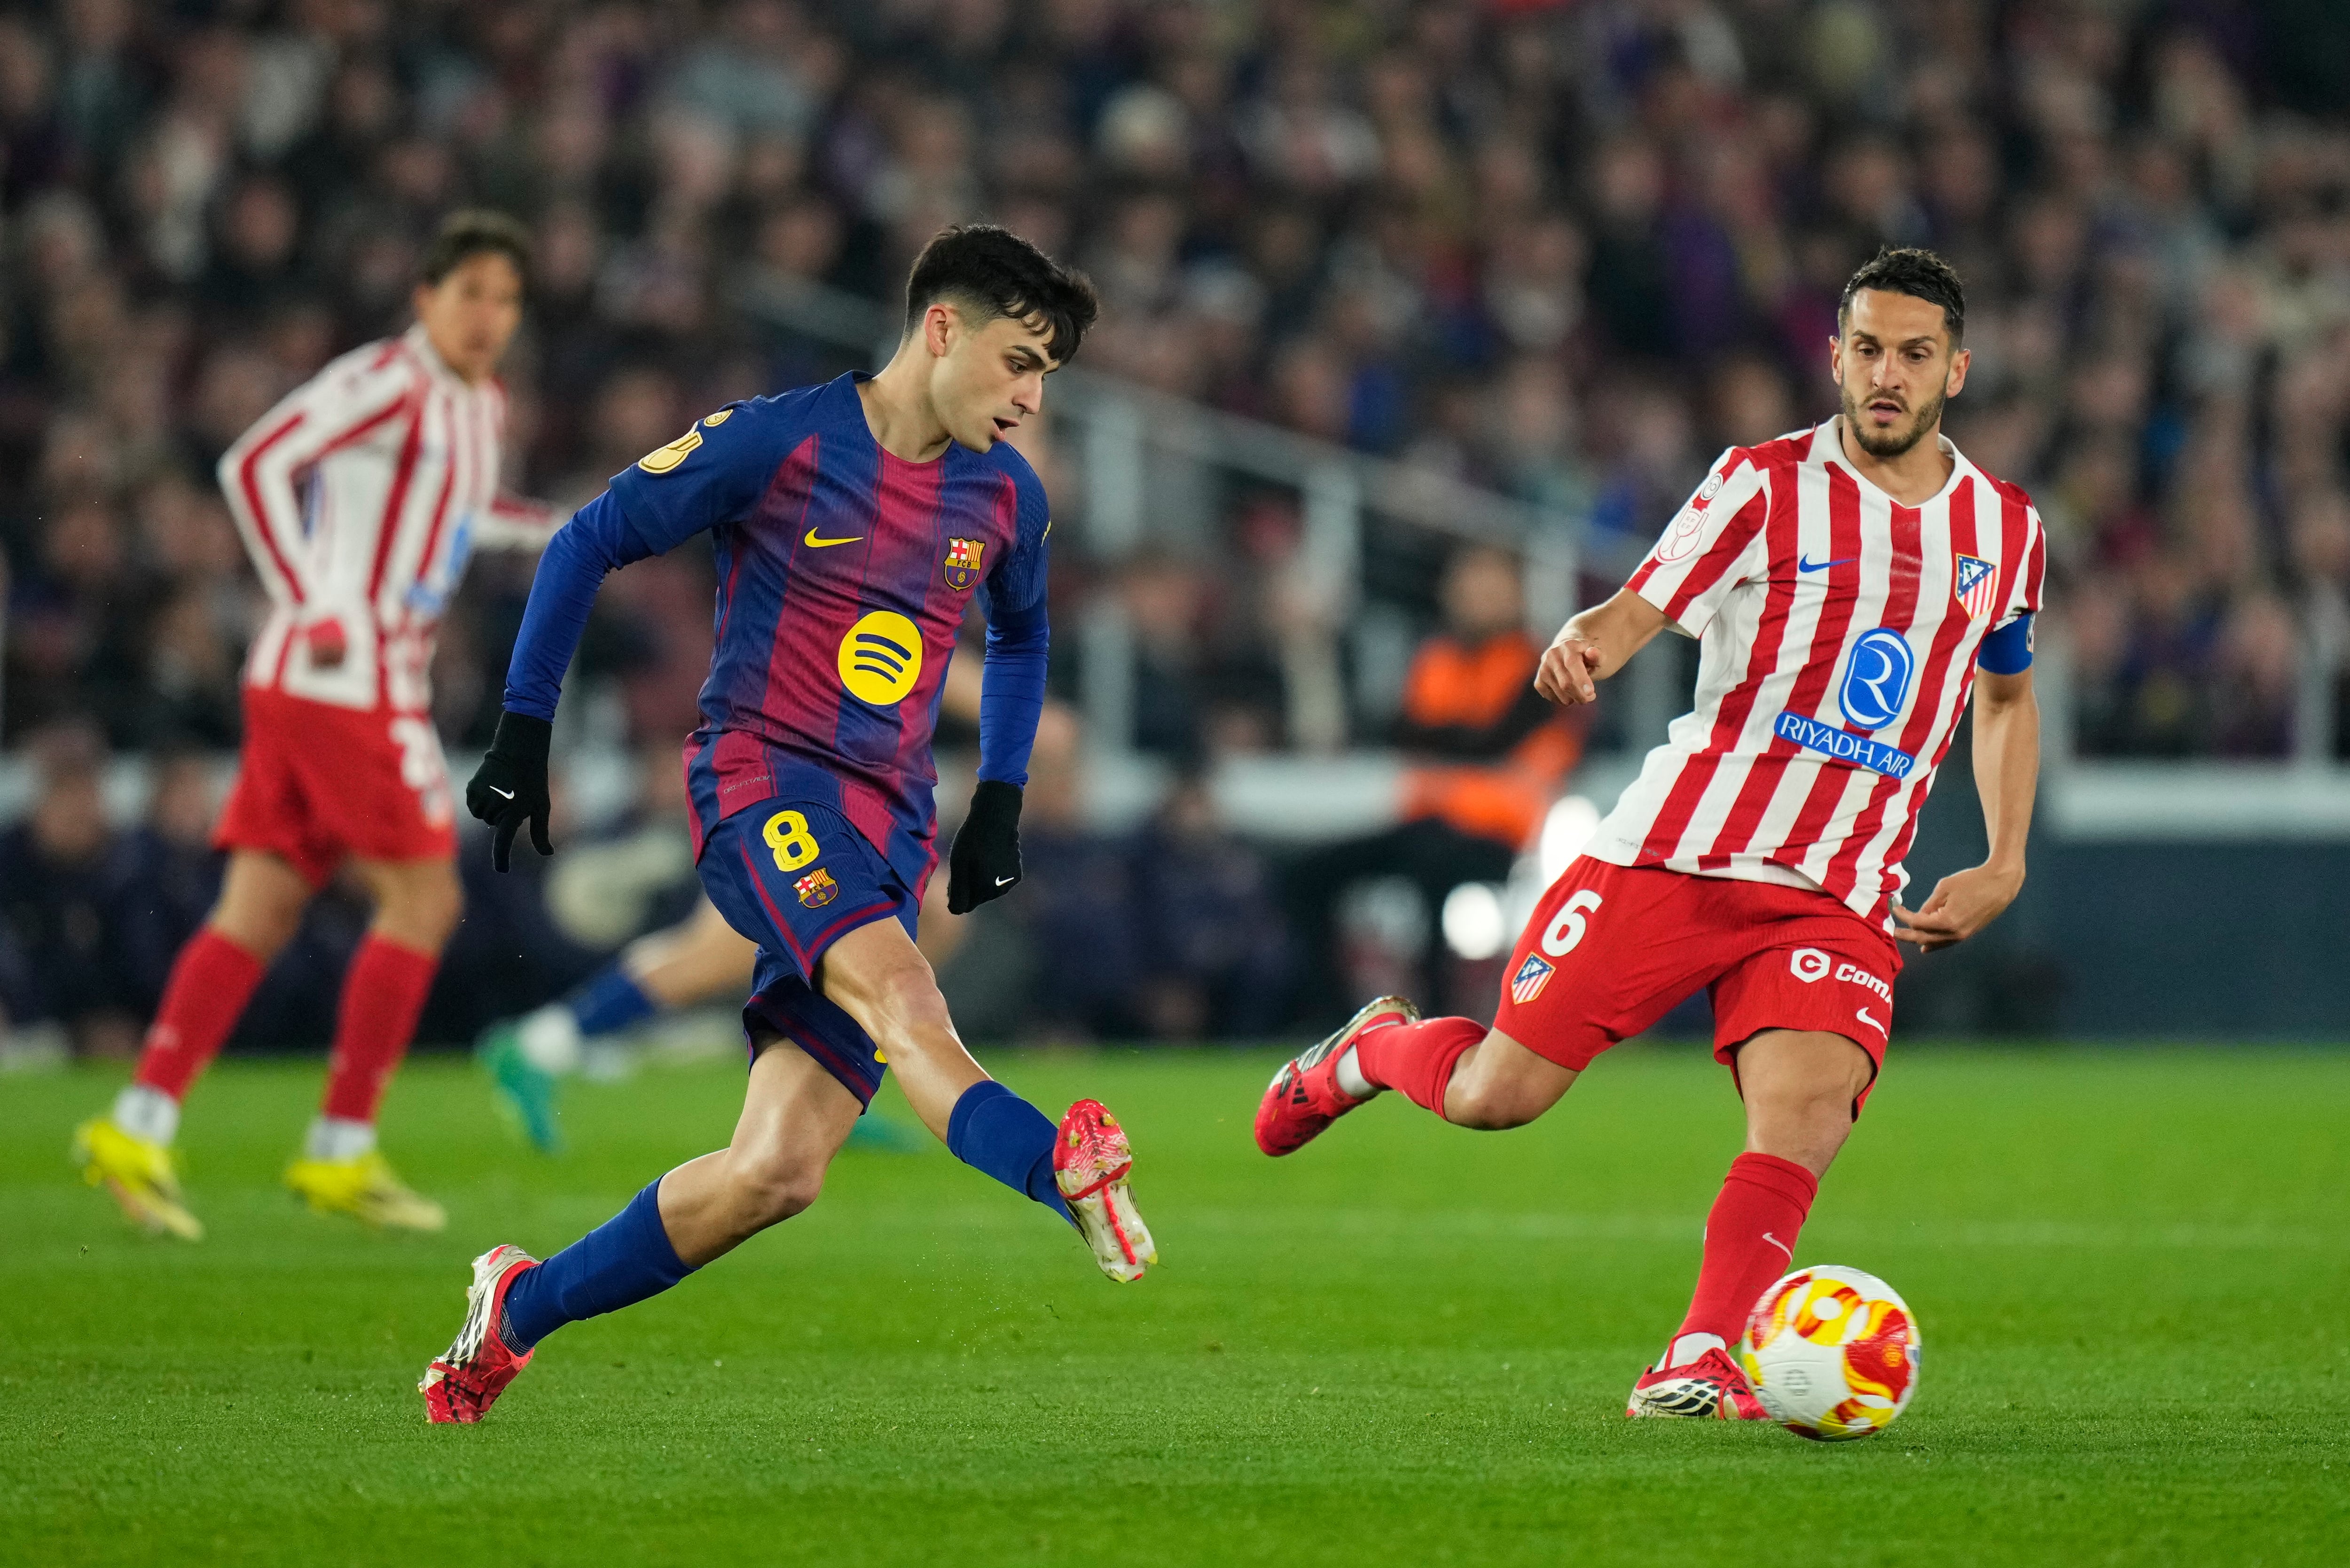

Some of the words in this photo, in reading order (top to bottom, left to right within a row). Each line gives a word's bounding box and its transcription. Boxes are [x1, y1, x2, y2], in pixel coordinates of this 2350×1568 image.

[1780, 714, 1875, 764] RIYADH
[1877, 750, 1910, 777] AIR
[762, 810, 820, 872] 8
[1542, 889, 1603, 957] 6
